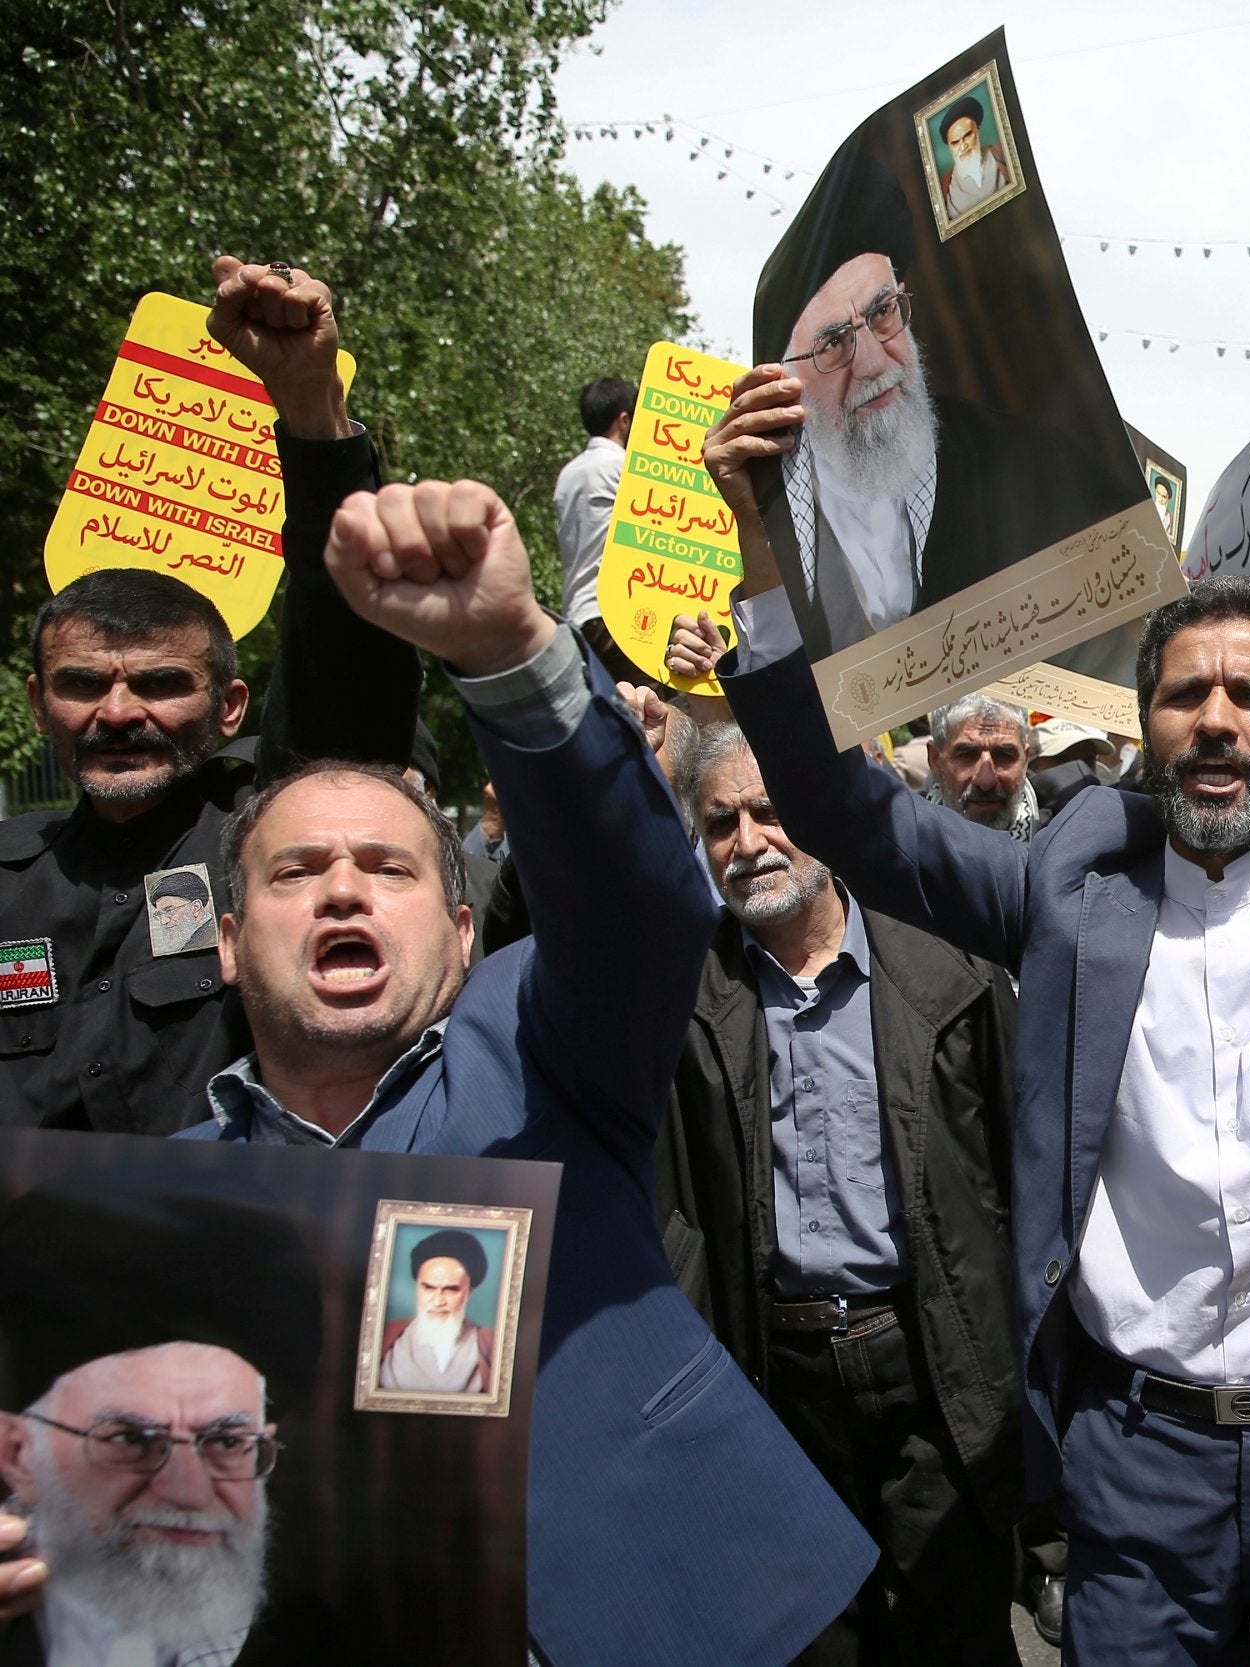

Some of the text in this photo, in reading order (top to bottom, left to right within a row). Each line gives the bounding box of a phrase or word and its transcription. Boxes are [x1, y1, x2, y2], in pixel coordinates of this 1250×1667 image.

[666, 355, 734, 400] مریکا
[650, 391, 716, 426] DOWN
[104, 404, 283, 478] DOWN WITH U.S.
[653, 418, 704, 465] ریکا
[634, 454, 696, 490] DOWN
[73, 474, 277, 553] DOWN WITH ISRAEL
[207, 475, 281, 516] الموت
[80, 514, 173, 555] للاسلام
[634, 524, 738, 571] Victory to
[628, 561, 720, 602] للاسلام
[1095, 544, 1145, 609] پشتیبان
[980, 620, 992, 651] تا
[1020, 593, 1040, 641] فقیه
